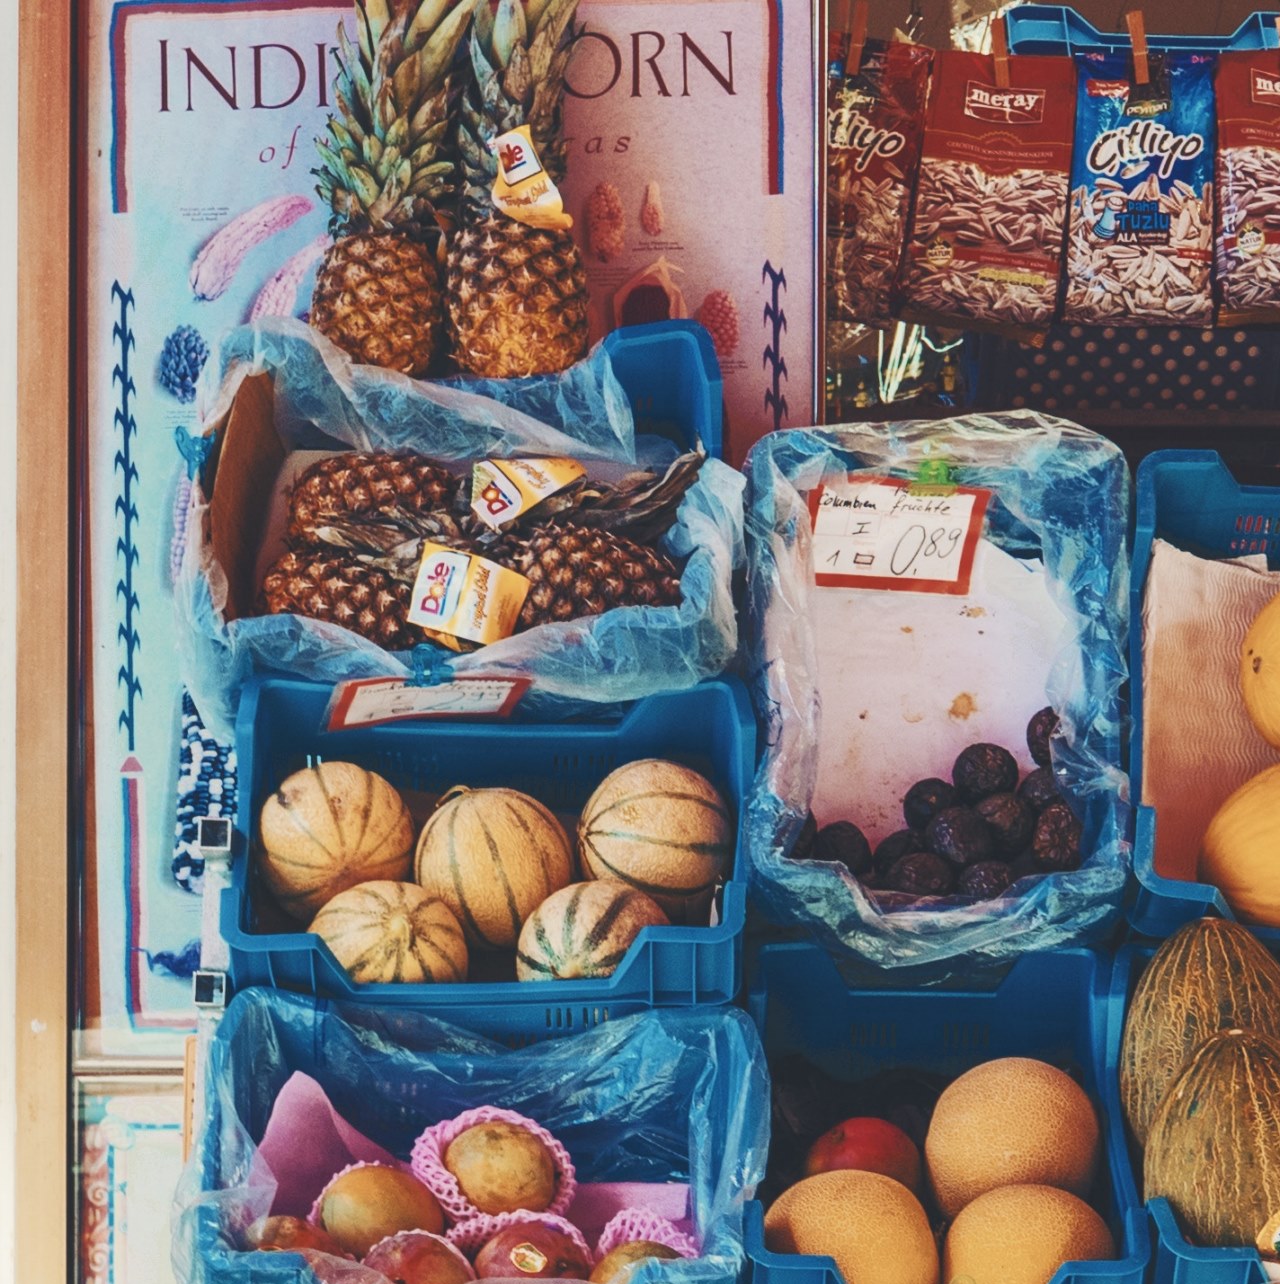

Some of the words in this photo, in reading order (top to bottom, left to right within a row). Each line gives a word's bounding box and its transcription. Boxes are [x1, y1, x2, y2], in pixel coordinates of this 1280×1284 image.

[157, 39, 332, 113] INDI
[560, 30, 736, 98] ORN
[970, 88, 1041, 111] meray
[1125, 101, 1168, 116] peyman
[259, 126, 301, 168] of
[1116, 232, 1138, 244] ALA
[817, 492, 877, 511] Columbien
[825, 549, 838, 567] 1
[420, 561, 451, 616] Dole
